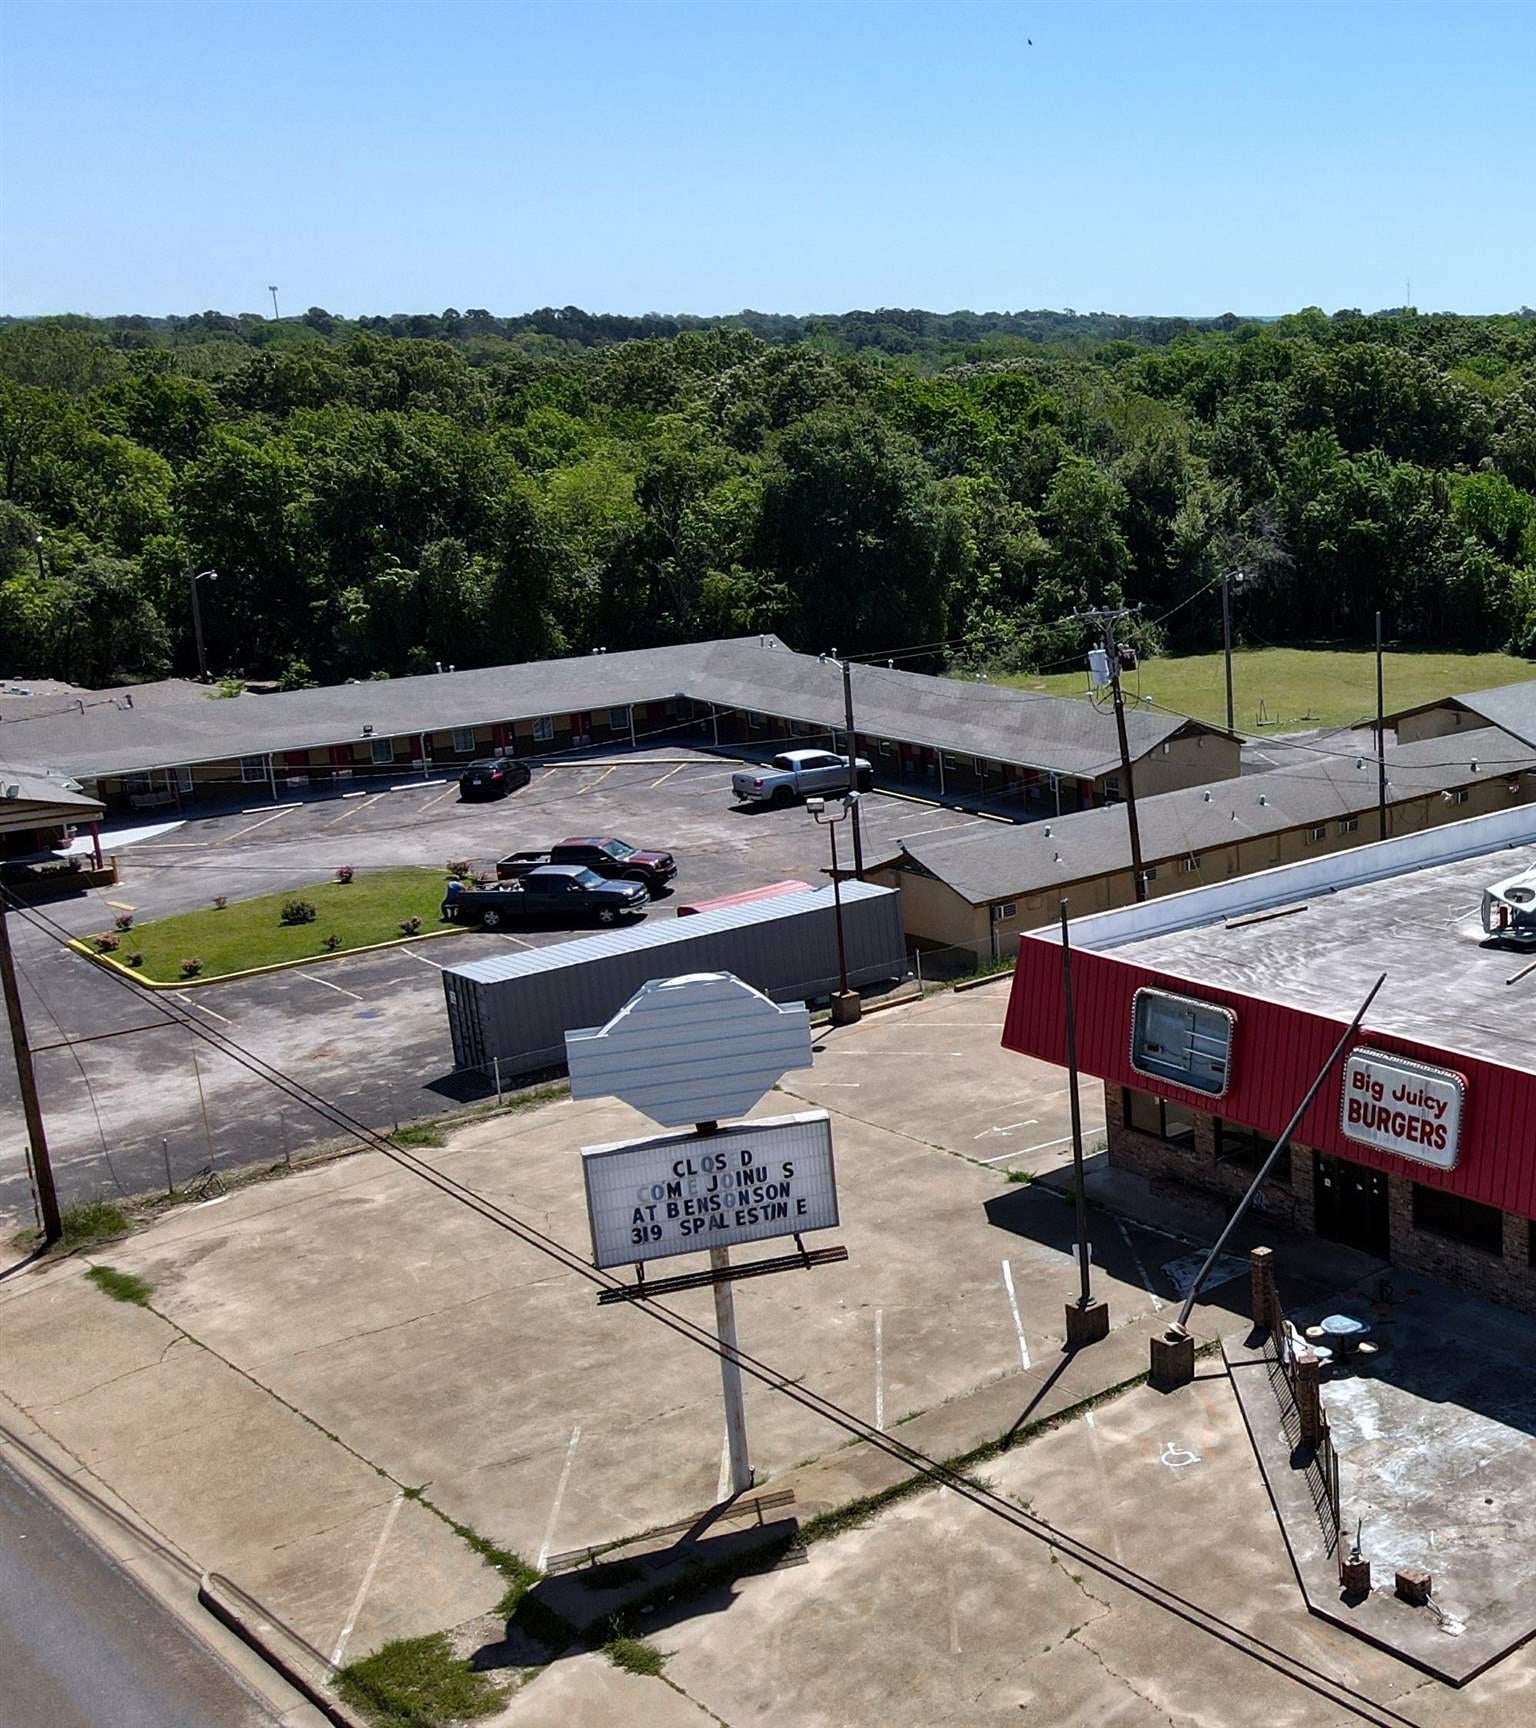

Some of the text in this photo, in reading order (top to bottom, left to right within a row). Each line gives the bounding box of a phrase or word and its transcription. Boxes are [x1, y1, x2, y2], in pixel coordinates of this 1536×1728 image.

[1352, 1071, 1448, 1119] Big Juicy
[1348, 1098, 1447, 1150] BURGERS
[633, 1205, 657, 1224] AT
[631, 1224, 663, 1244] 319
